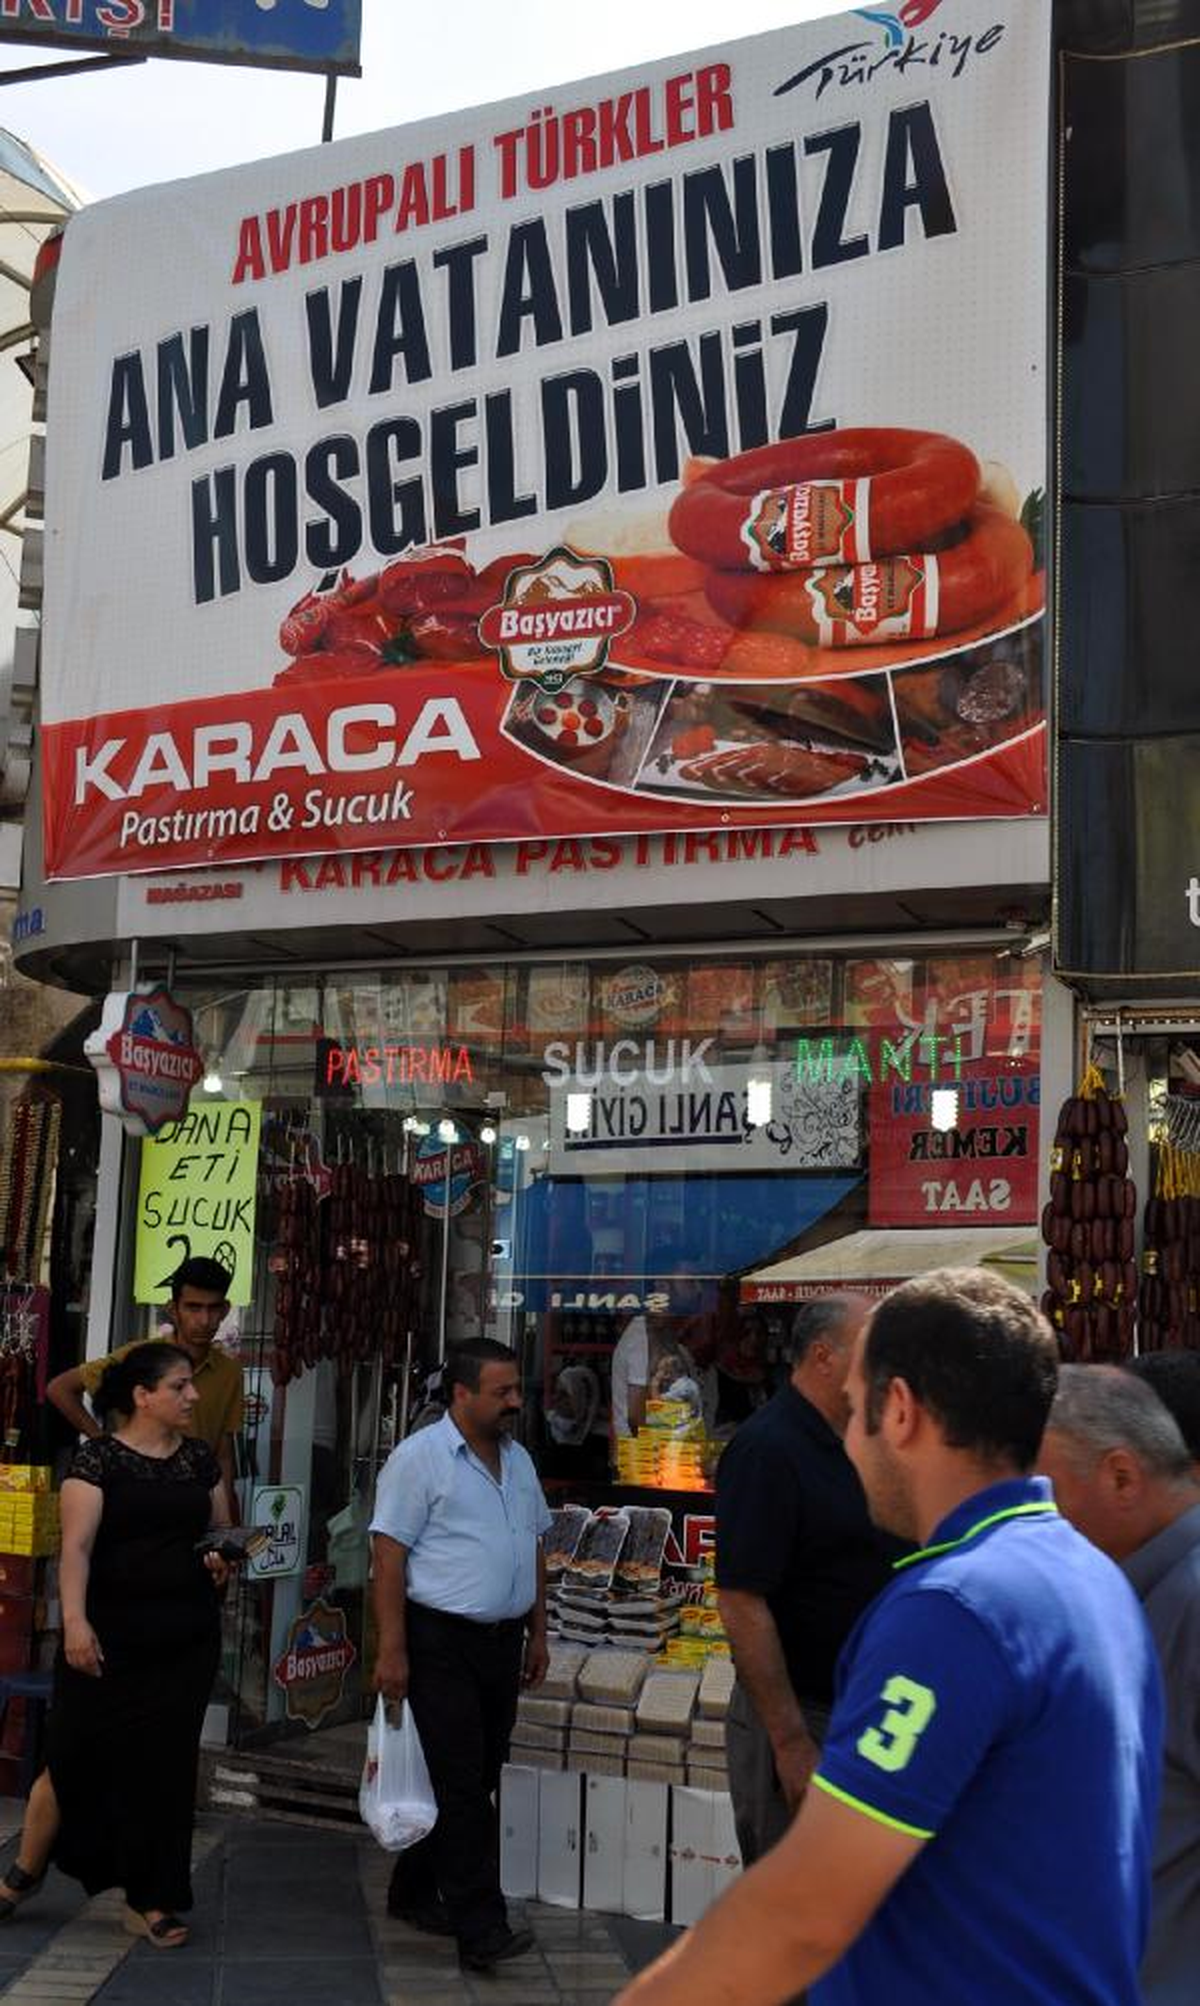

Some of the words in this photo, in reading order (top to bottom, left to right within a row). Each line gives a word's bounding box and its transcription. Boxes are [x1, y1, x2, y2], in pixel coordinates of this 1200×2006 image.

[772, 24, 1005, 99] Türkiye
[232, 145, 476, 285] AVRUPALI
[494, 63, 735, 199] TÜRKLER
[102, 306, 273, 481] ANA
[305, 100, 957, 409] VATANINIZA
[500, 605, 613, 639] Başyazıcı
[75, 698, 481, 805] KARACA
[119, 801, 260, 849] Pastırma
[268, 793, 294, 831] &
[301, 781, 413, 829] Sucuk
[279, 843, 496, 892] KARACA
[326, 1044, 474, 1088] PASTIRMA
[541, 1038, 717, 1088] SUCUK
[795, 1036, 963, 1086] MANTI
[168, 1149, 242, 1184] ETİ
[143, 1191, 252, 1233] SUCUK
[856, 1675, 937, 1772] 3
